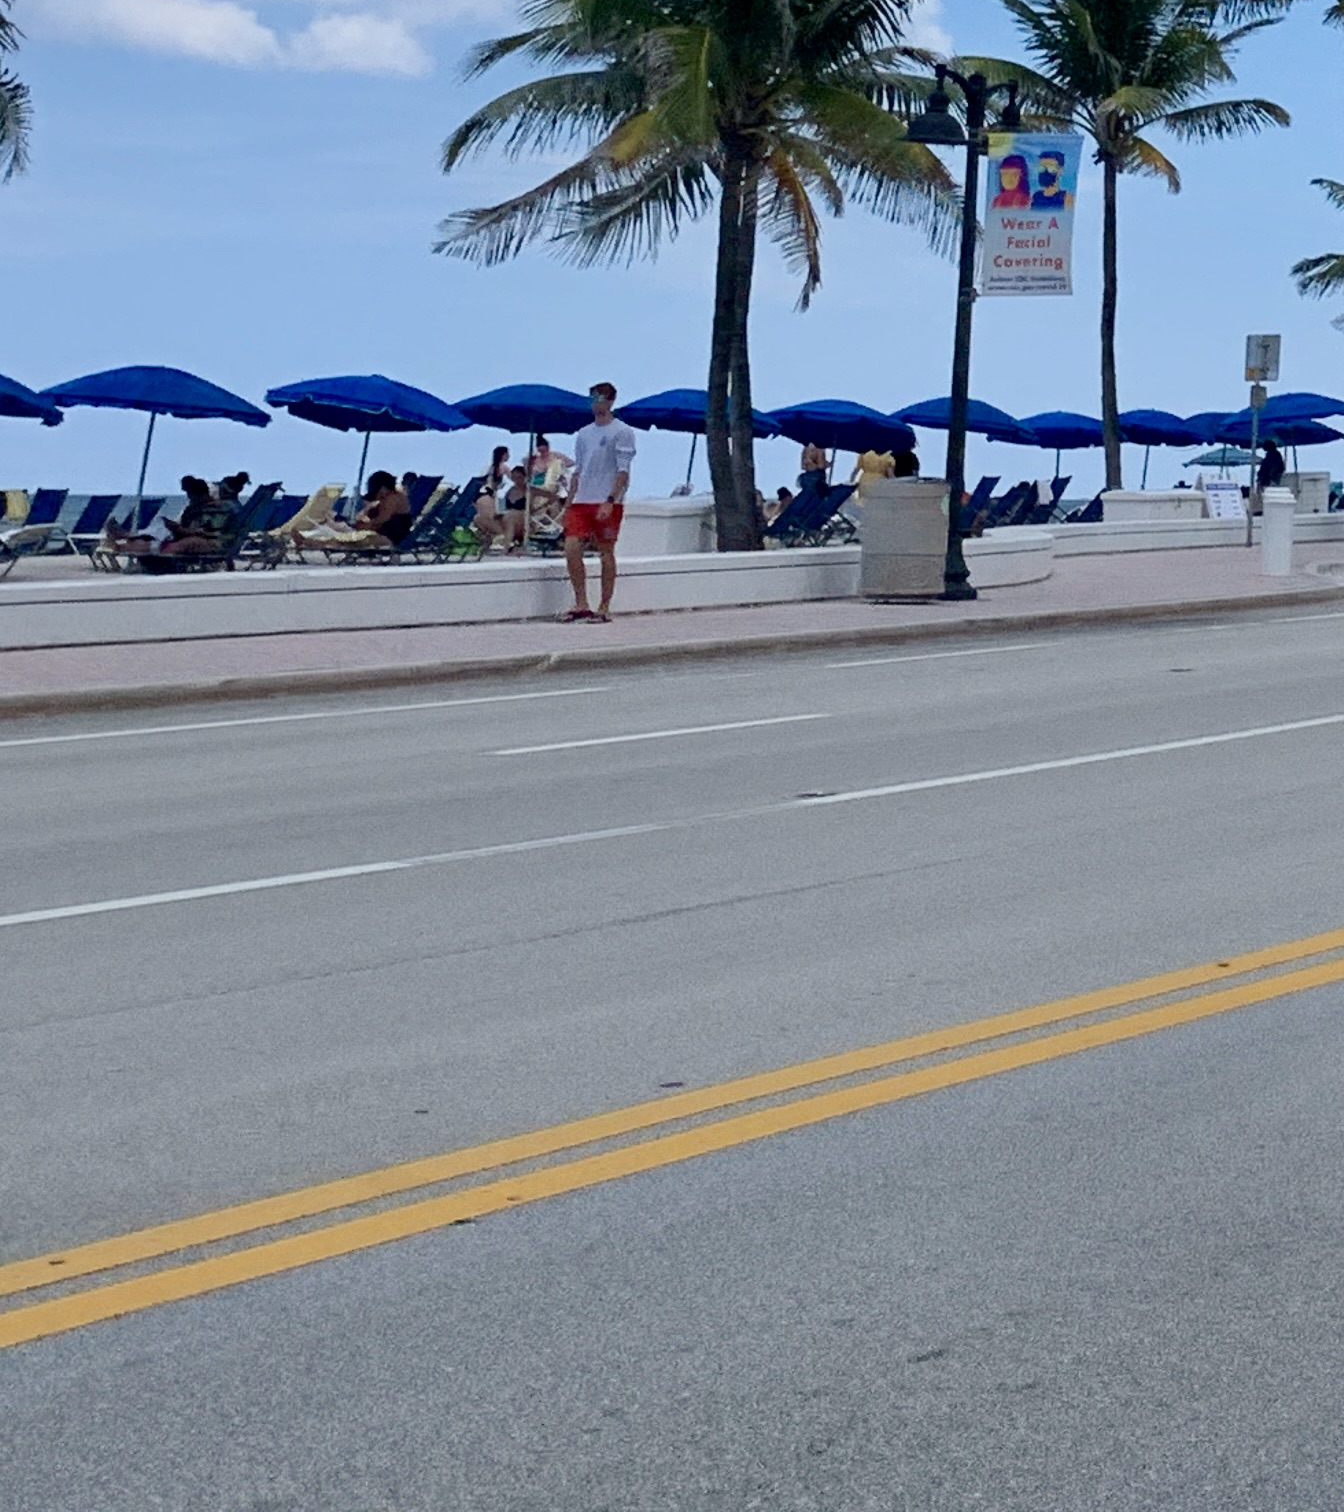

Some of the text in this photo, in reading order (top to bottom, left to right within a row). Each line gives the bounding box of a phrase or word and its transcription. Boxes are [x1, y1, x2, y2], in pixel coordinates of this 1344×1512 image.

[1001, 216, 1060, 230] Wear A
[1006, 234, 1051, 249] Facial
[993, 253, 1065, 271] Covering
